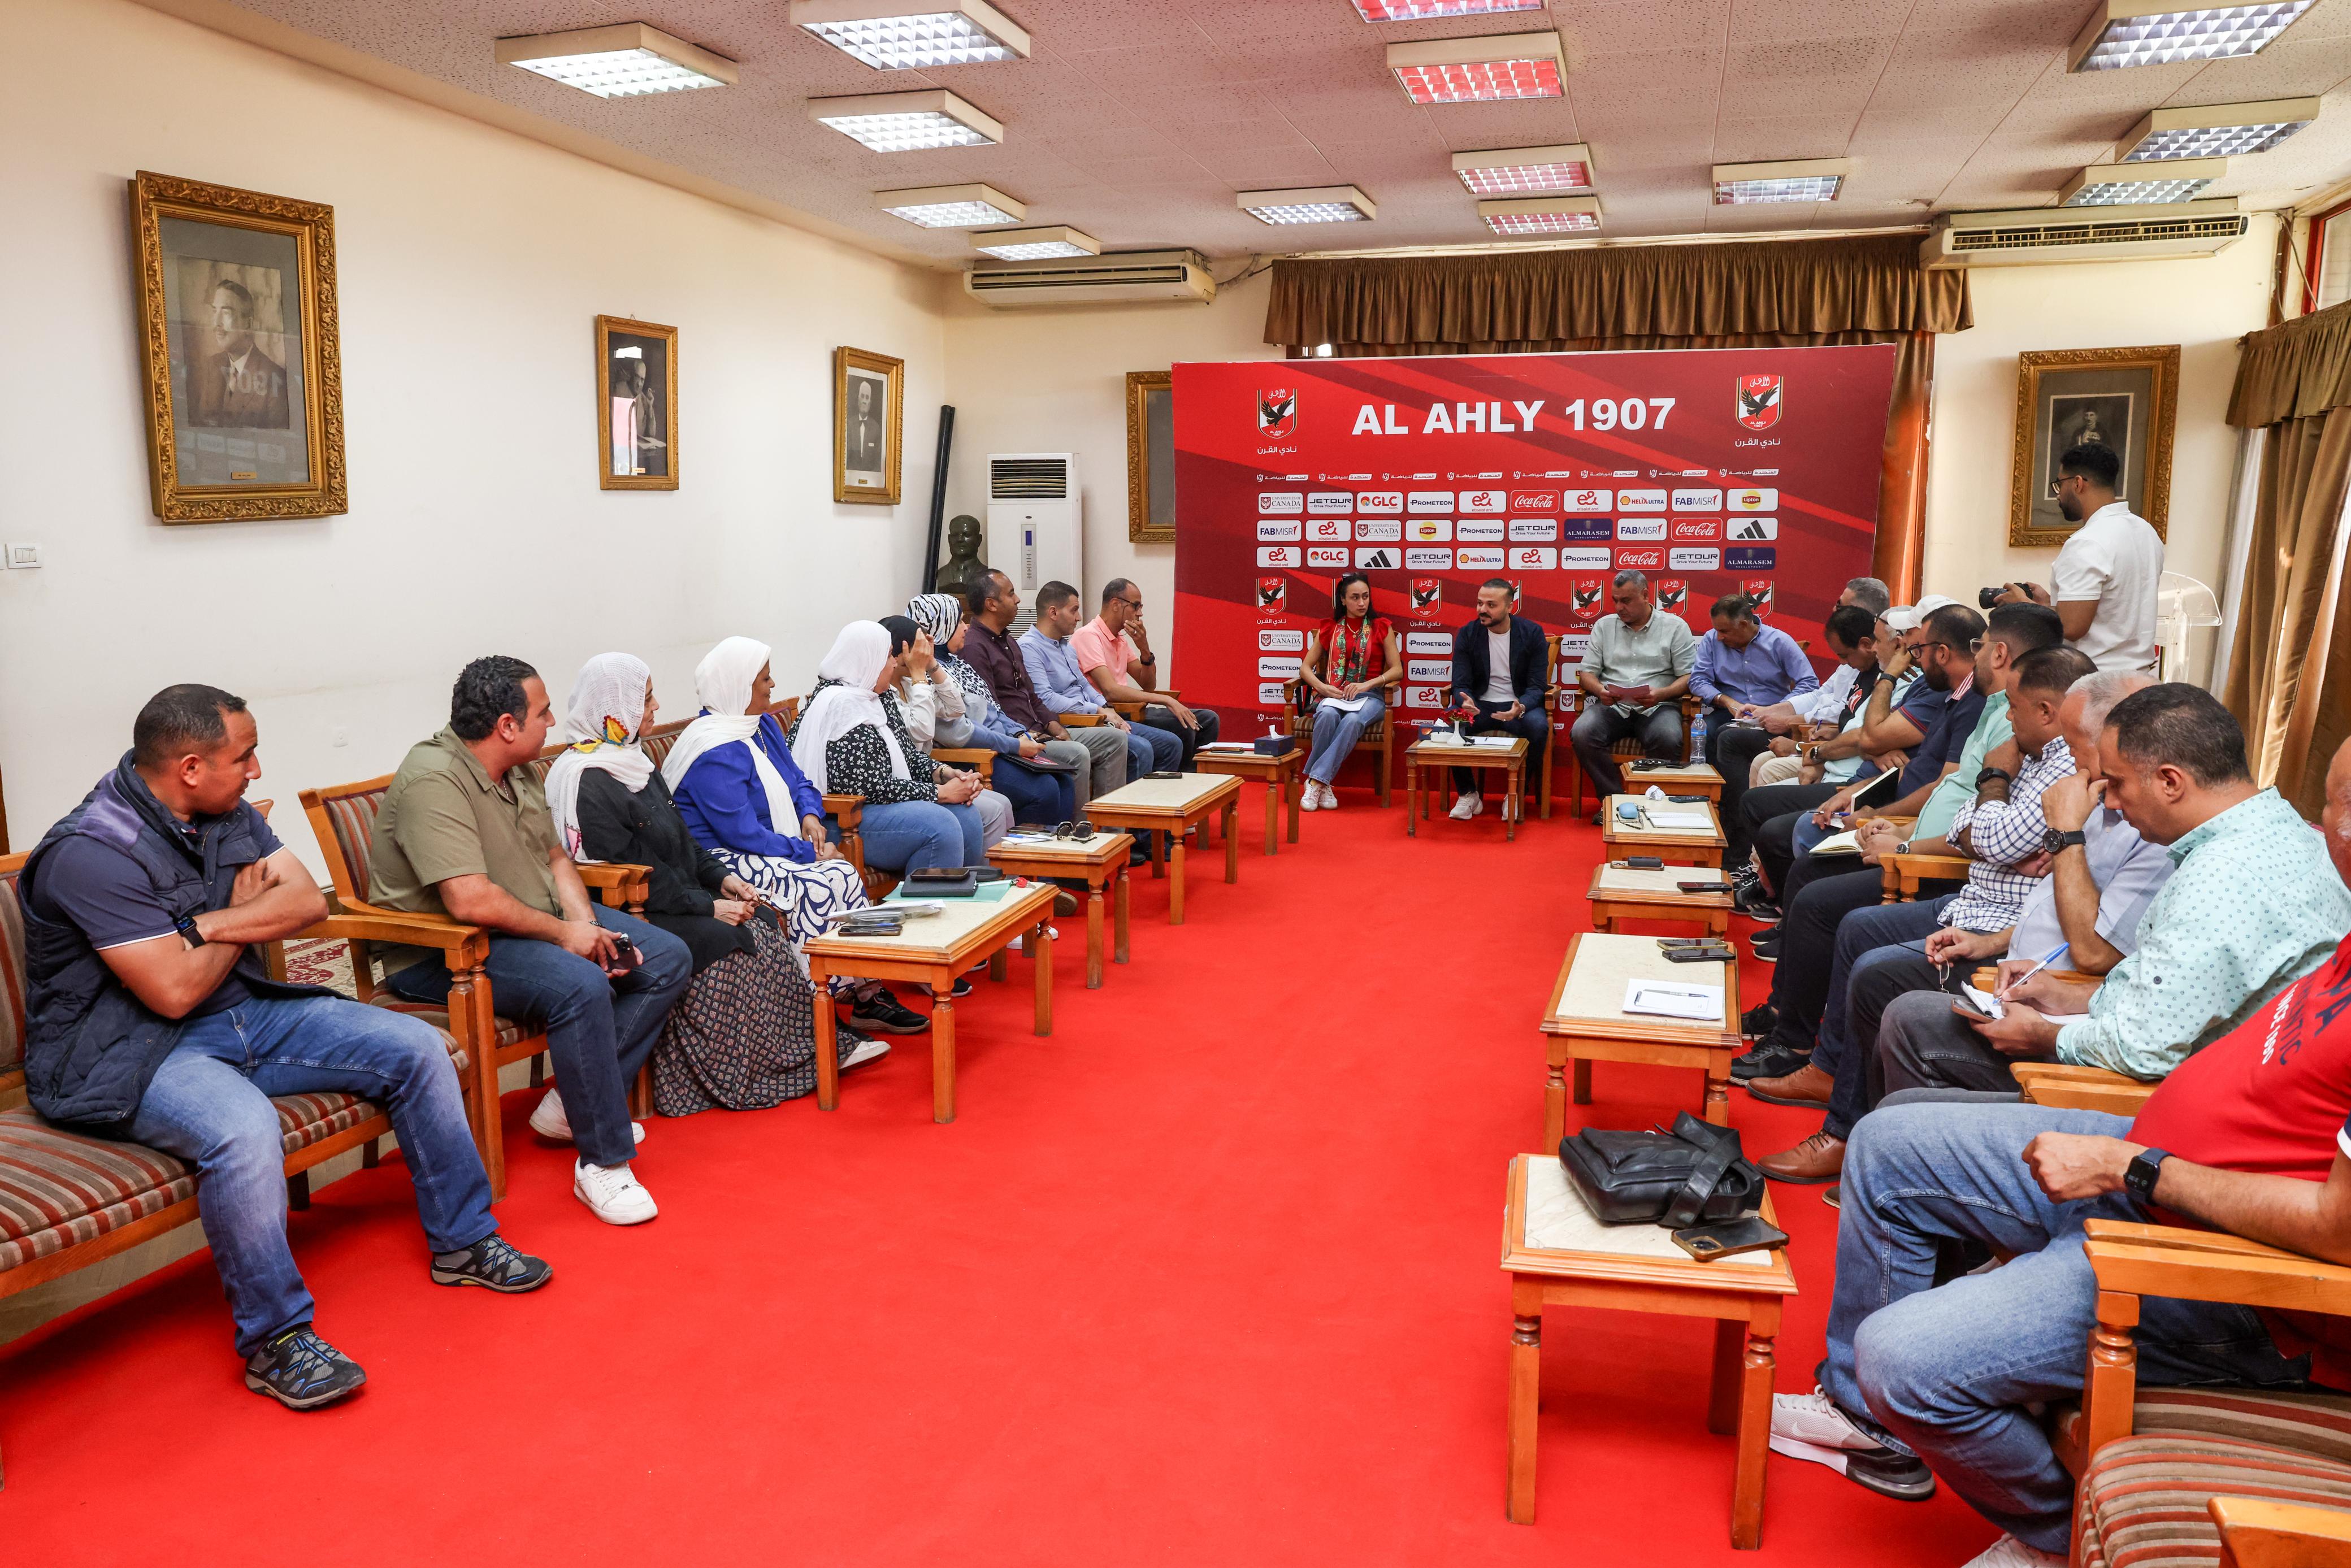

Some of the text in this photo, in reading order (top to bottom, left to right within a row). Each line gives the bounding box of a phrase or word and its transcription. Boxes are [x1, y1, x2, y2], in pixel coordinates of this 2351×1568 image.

[1352, 398, 1676, 435] AL AHLY 1907
[1279, 446, 1297, 455] نادي
[1735, 438, 1781, 449] نادي القرن
[1372, 496, 1397, 506] GLC
[1472, 492, 1493, 507] e&
[1515, 495, 1555, 508] Coca-Cola
[1577, 491, 1598, 506] e&
[1318, 521, 1338, 535] e&
[1676, 523, 1718, 536] Coca-Cola
[1268, 548, 1288, 562] e&
[1321, 551, 1344, 561] GLC
[1521, 549, 1542, 563] e&
[1619, 552, 1660, 565] Coca-Cola
[1419, 688, 1438, 702] e&
[276, 1331, 298, 1345] MERRELL
